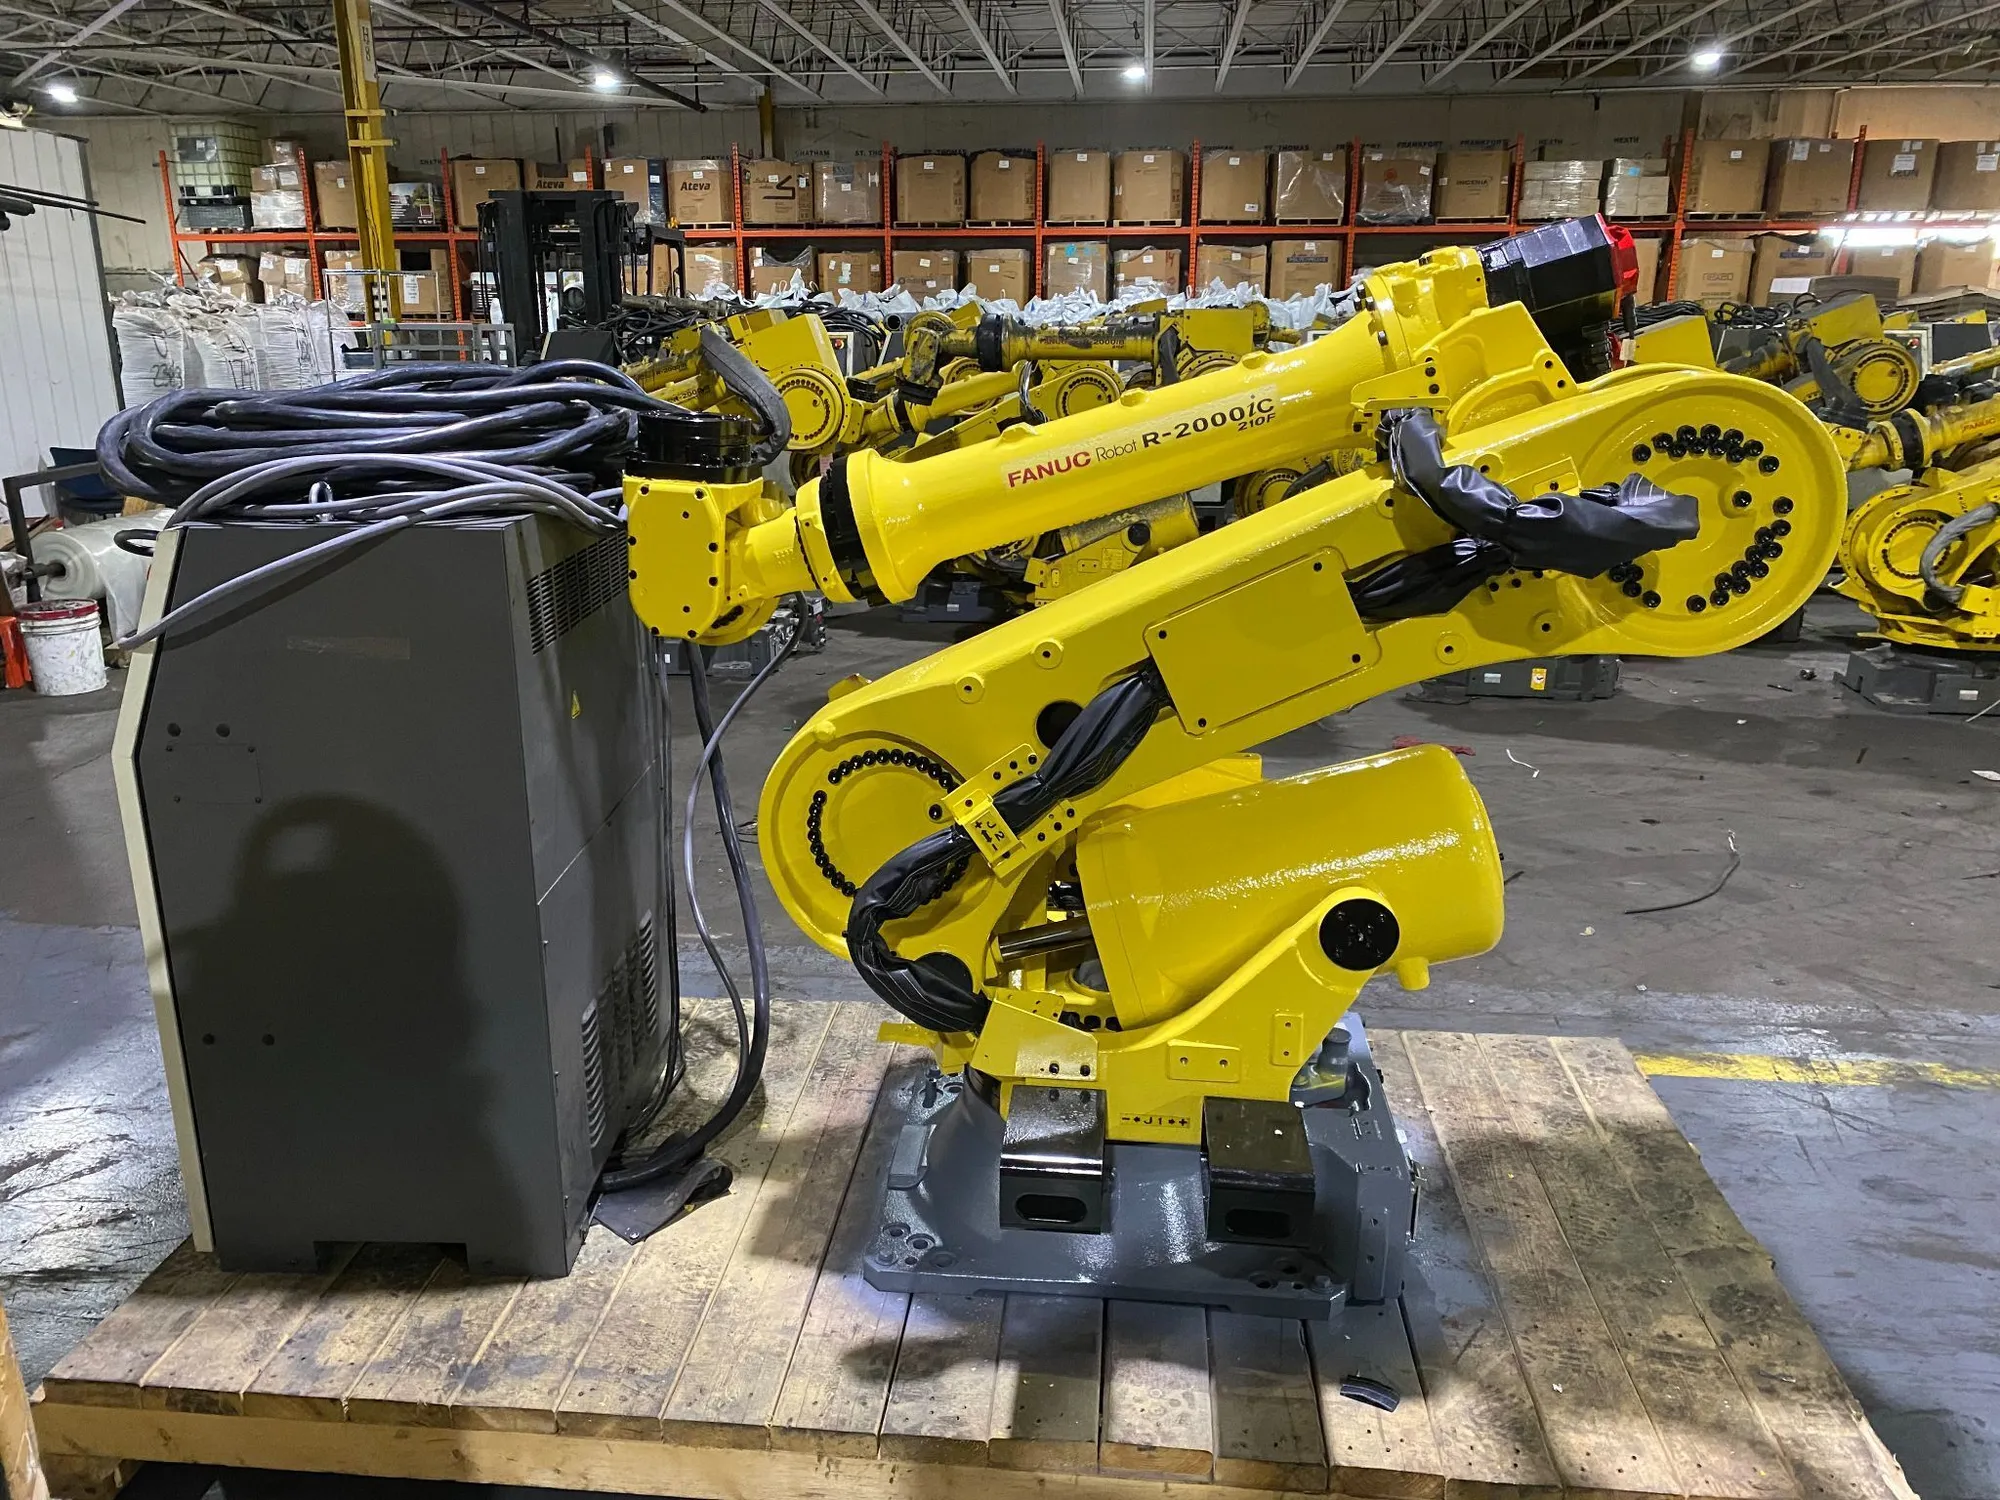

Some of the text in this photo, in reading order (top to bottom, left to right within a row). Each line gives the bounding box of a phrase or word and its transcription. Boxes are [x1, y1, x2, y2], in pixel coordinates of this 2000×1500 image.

[1613, 136, 1639, 144] HEATH
[795, 149, 830, 157] CHATHAM
[535, 178, 565, 190] Ateva
[680, 181, 712, 192] Ateva
[1237, 412, 1276, 432] 210F
[1007, 394, 1275, 489] FANUC Robot R-2000iC
